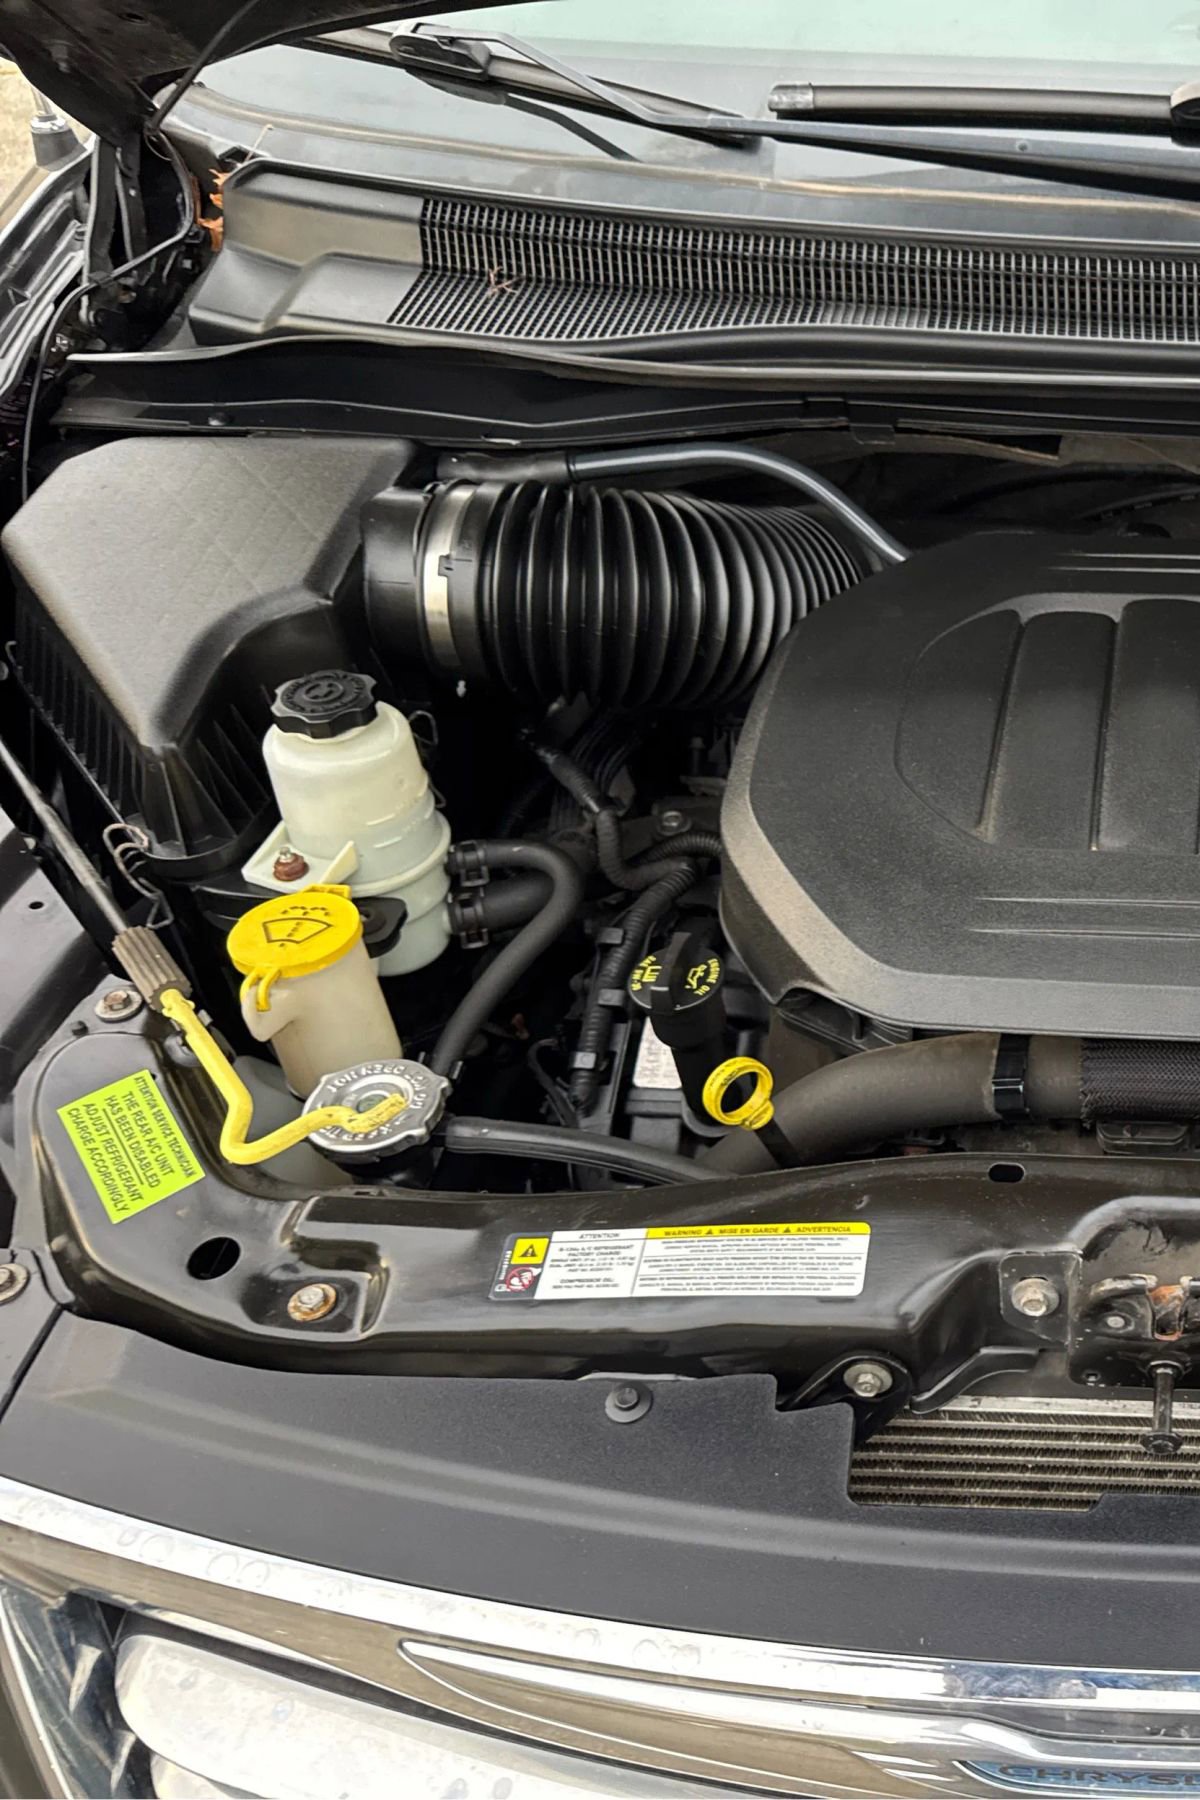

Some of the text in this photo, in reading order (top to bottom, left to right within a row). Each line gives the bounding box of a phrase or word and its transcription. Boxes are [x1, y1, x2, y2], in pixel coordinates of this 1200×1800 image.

[694, 958, 720, 996] ENGINE OIL
[66, 1106, 131, 1212] CHARGE ACCORDINGLY
[81, 1100, 144, 1202] ADJUST REFRIGERANT
[104, 1094, 161, 1189] HAS BEEN DISABLED
[121, 1090, 174, 1177] THE REAR A/C UNIT
[134, 1076, 196, 1178] ATTENTION SERVICE TECHNICIAN
[664, 1229, 702, 1237] WARNING
[719, 1227, 737, 1235] MISE
[751, 1226, 779, 1234] GARDE
[796, 1225, 851, 1233] ADVERTENCIA
